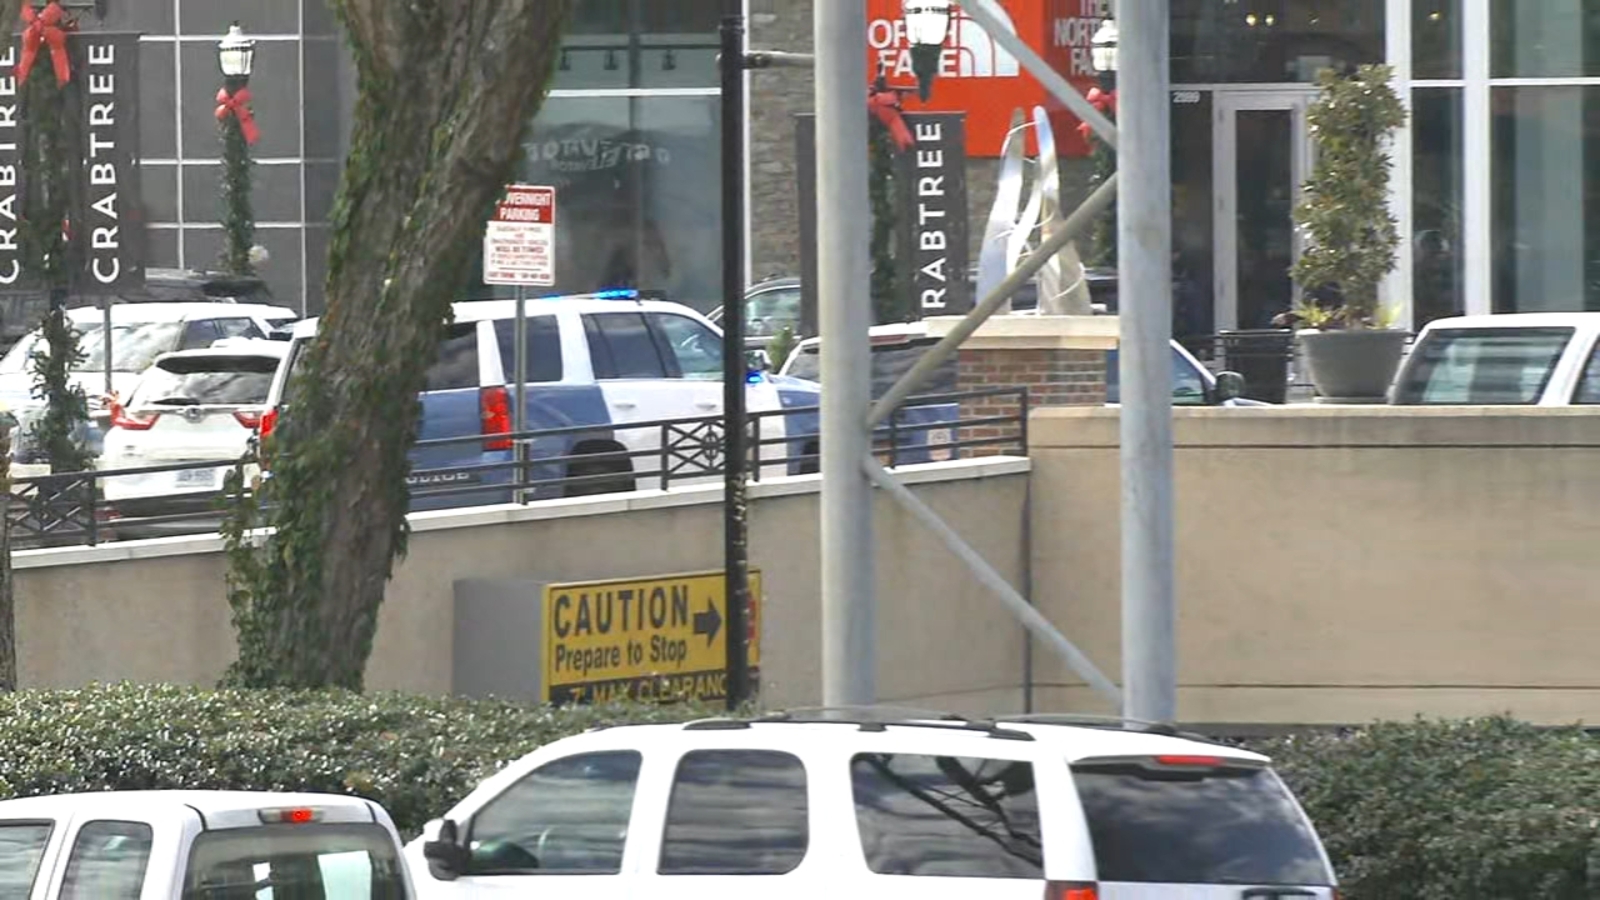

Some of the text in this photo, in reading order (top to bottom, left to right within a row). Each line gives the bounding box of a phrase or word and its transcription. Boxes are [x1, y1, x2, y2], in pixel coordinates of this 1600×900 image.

[1053, 17, 1103, 48] NORT
[878, 49, 958, 78] FAE
[88, 44, 120, 284] CRABTREE
[500, 207, 540, 220] PARKING
[916, 122, 947, 310] RABTREE
[554, 585, 688, 638] CAUTION
[554, 634, 687, 674] Prepare to Stop
[637, 673, 728, 704] CLEARANC
